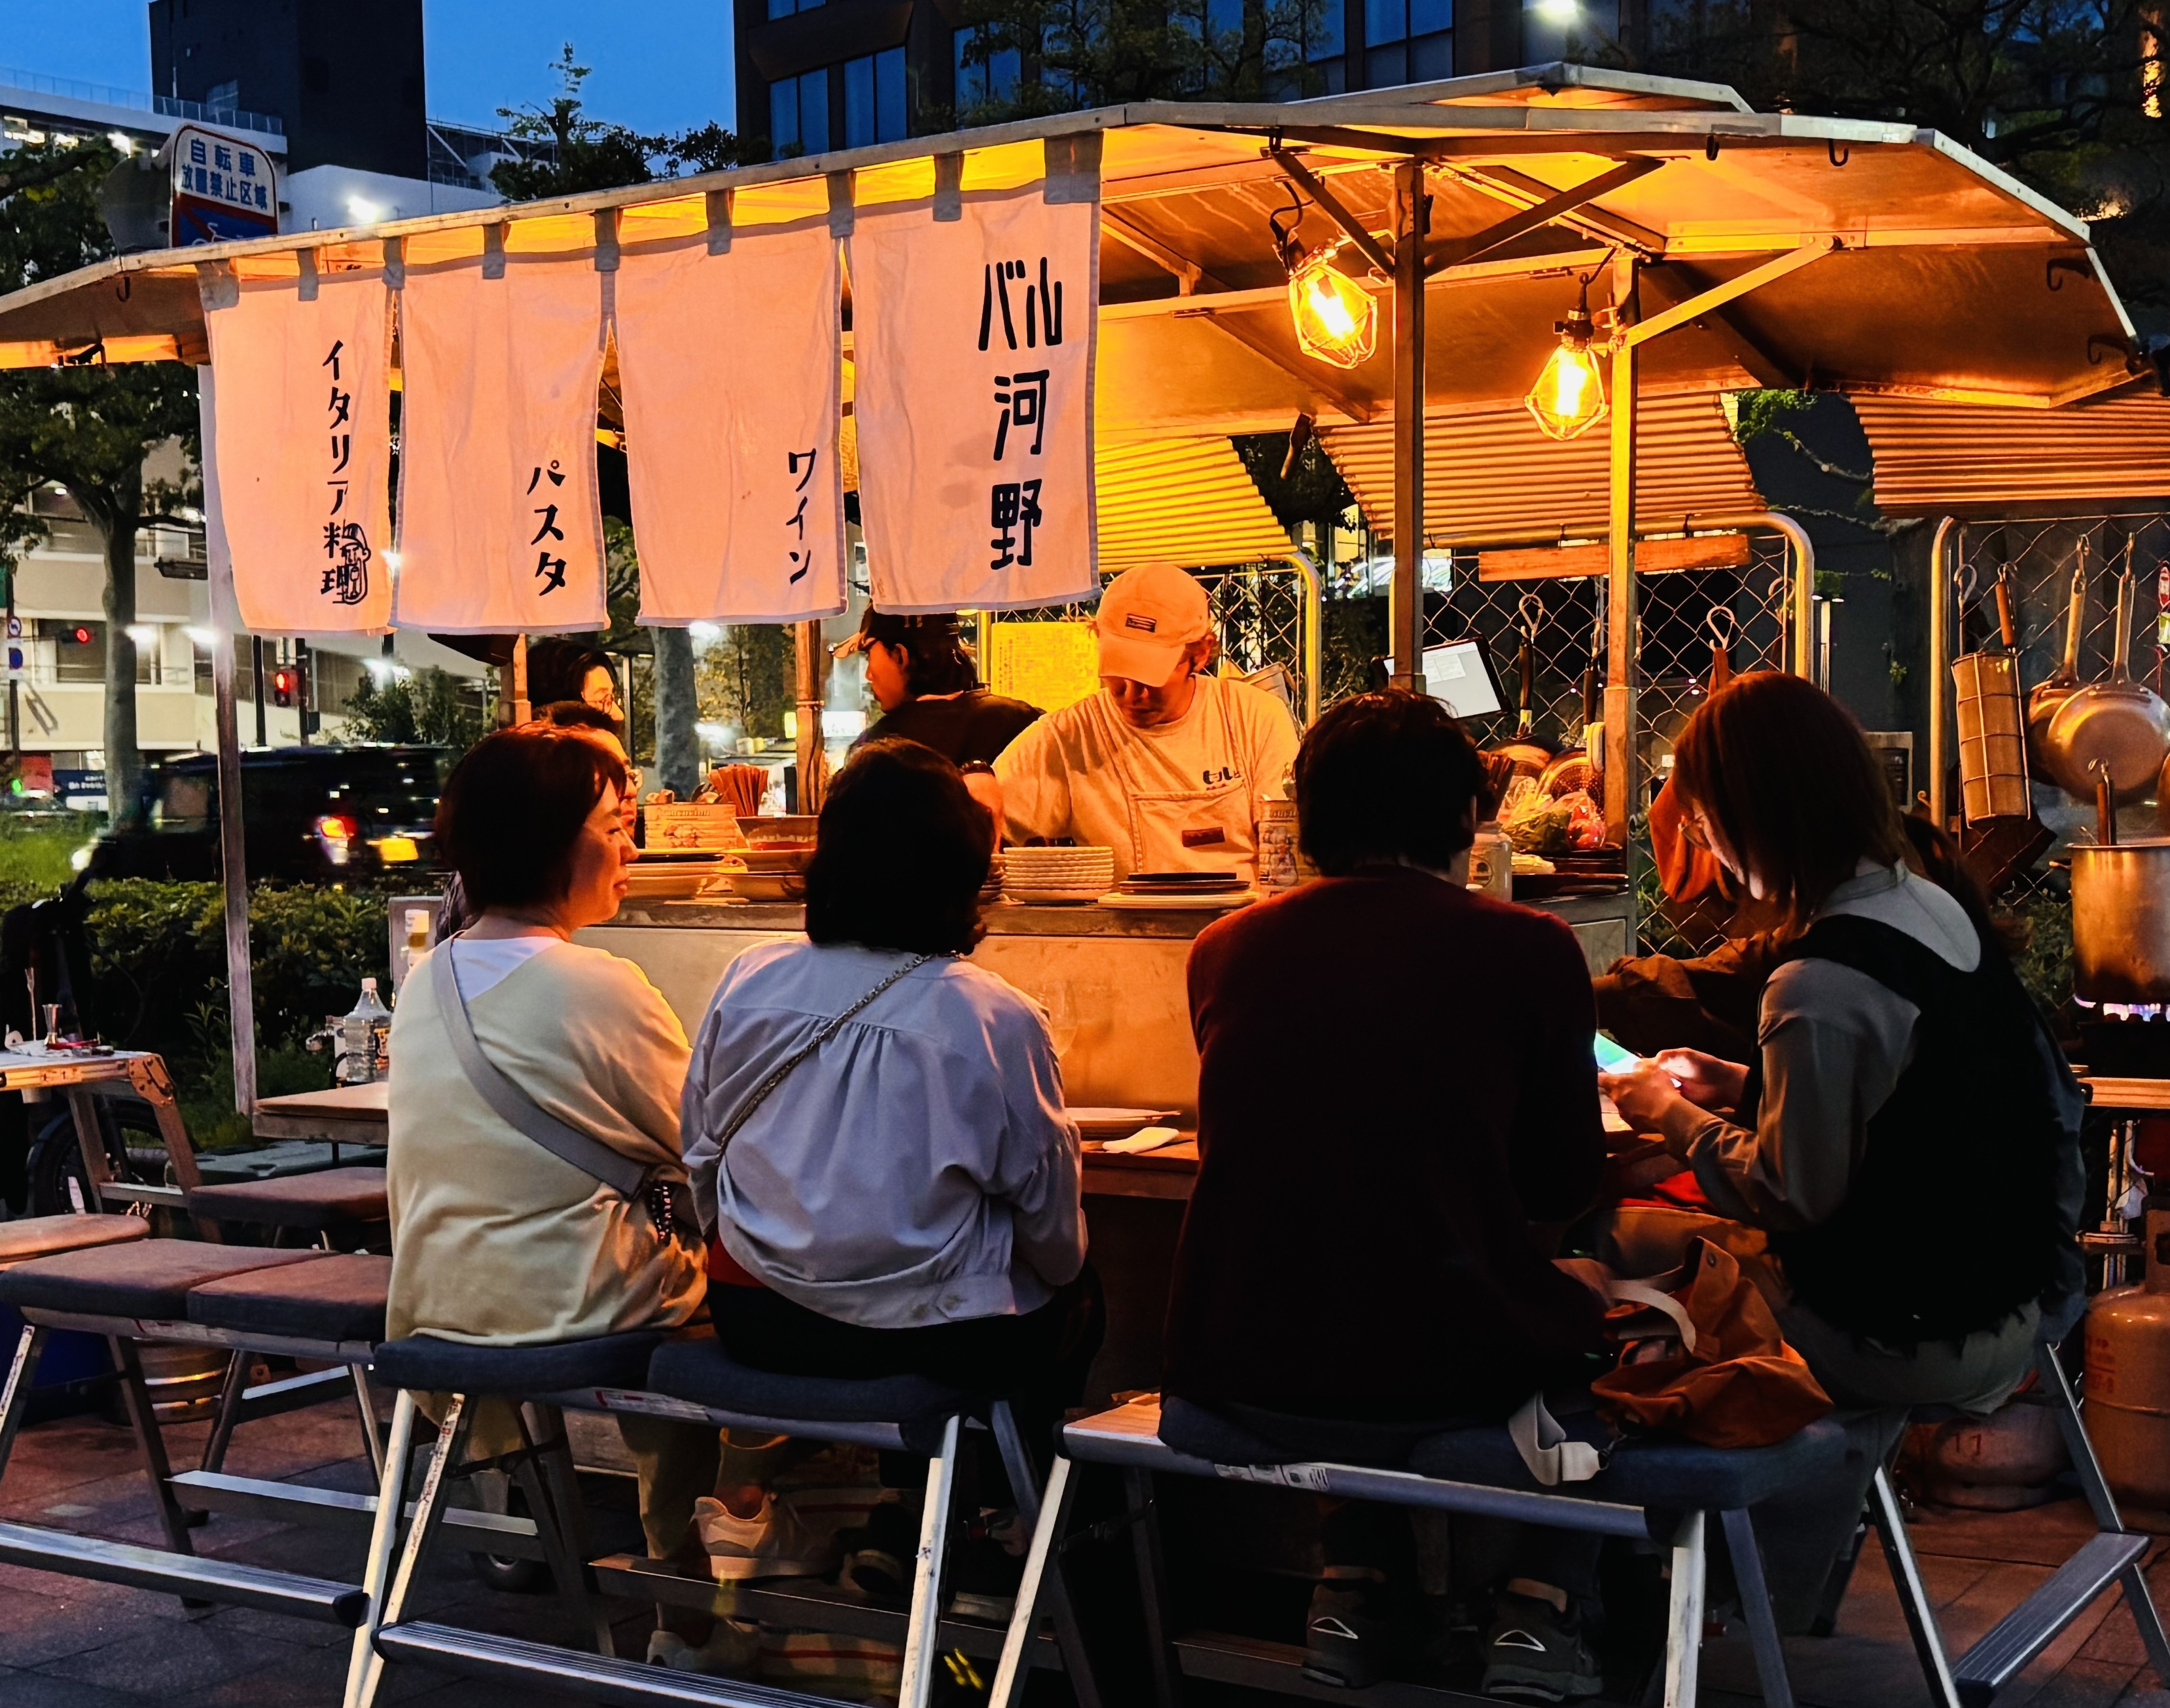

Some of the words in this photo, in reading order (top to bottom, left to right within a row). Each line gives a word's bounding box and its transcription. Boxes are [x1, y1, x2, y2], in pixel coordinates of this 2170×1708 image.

[191, 138, 256, 177] 自転車
[320, 340, 354, 604] イタリア料理
[527, 459, 567, 597] パスタ
[785, 448, 817, 585] ワイン
